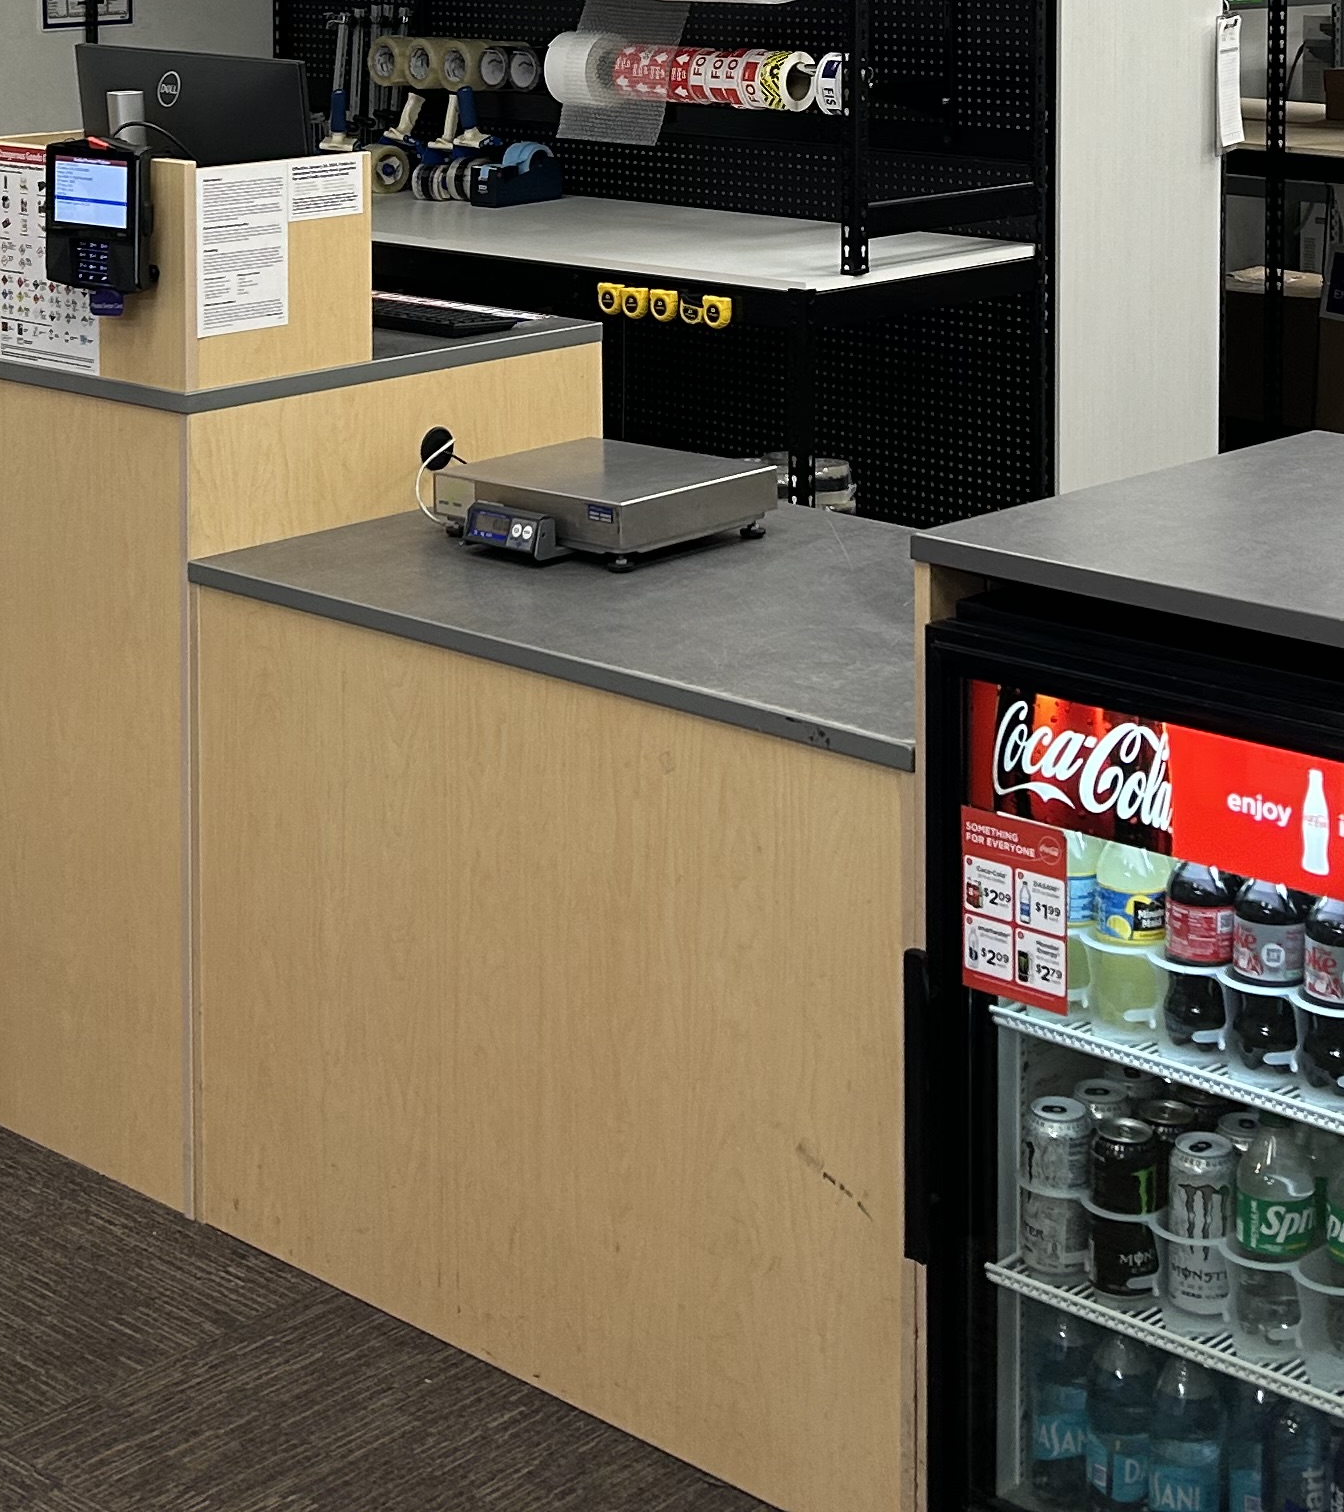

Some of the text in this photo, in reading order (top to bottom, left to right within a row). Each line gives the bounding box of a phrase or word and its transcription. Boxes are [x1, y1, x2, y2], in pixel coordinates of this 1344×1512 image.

[992, 701, 1173, 831] Coca-Cola
[1227, 793, 1292, 827] enjoy
[965, 821, 1019, 842] SOMETHING
[965, 832, 984, 845] FOR
[986, 837, 1035, 858] EVERYONE
[1260, 1205, 1315, 1243] Spr
[1154, 1472, 1200, 1510] SANI
